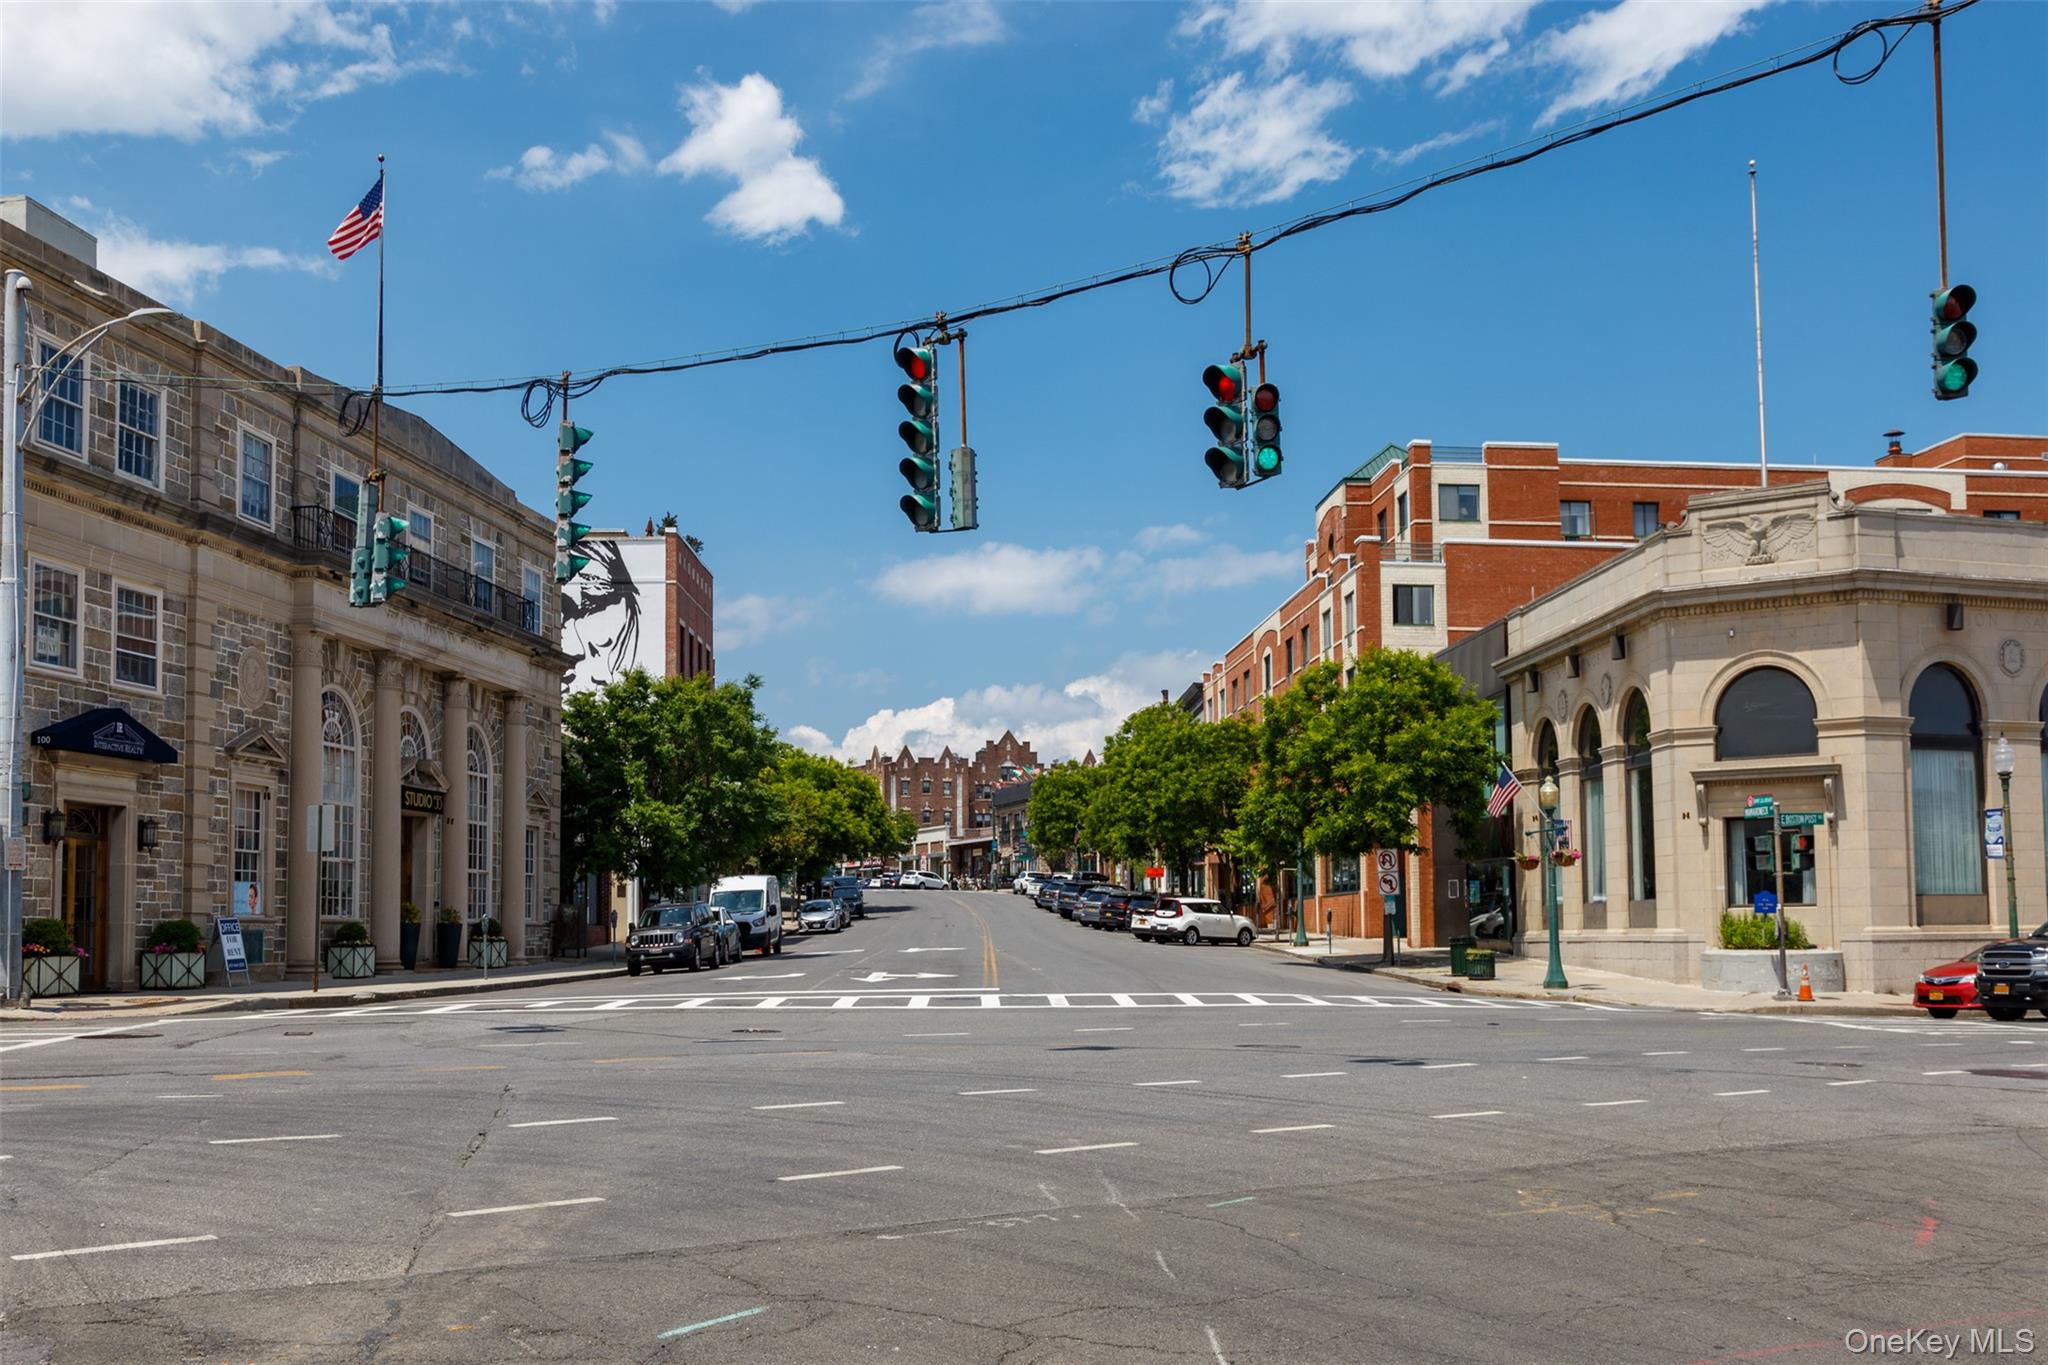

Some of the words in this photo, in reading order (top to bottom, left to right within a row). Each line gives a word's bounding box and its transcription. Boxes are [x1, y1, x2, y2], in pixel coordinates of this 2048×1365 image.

[37, 736, 51, 744] 100
[405, 790, 433, 809] STUDIO
[1804, 814, 1817, 825] POST
[221, 922, 240, 933] OFFICE
